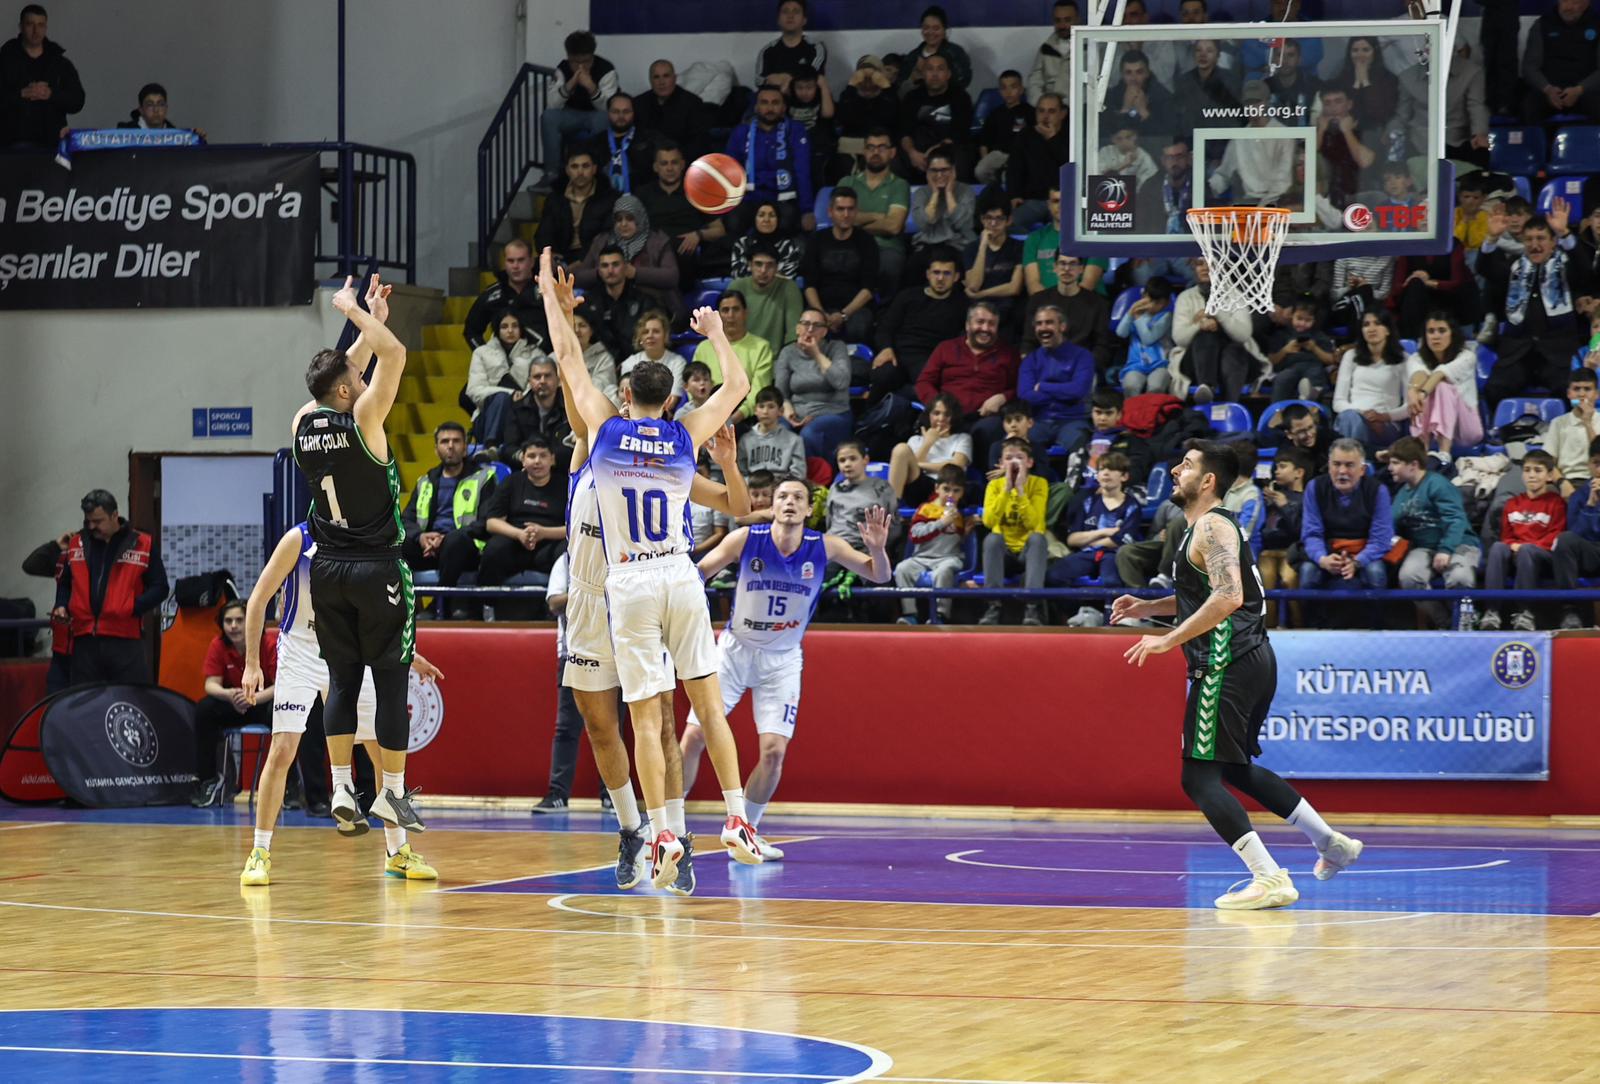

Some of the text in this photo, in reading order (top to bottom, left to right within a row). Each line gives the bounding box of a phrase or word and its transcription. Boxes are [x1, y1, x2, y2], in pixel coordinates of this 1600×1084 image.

[1202, 104, 1307, 119] www.tbf.org.tr
[16, 187, 172, 231] Belediye
[1090, 212, 1133, 222] ALTYAPI
[1374, 205, 1426, 229] TBF
[114, 243, 200, 279] Diler
[321, 432, 350, 454] ÇOLAK
[750, 444, 783, 467] ADIDAS
[320, 475, 348, 529] 1
[621, 487, 668, 543] 10
[768, 595, 787, 617] 15
[1296, 665, 1431, 695] KÜTAHYA
[274, 701, 306, 712] sidera
[782, 703, 798, 725] 15
[1416, 713, 1534, 742] KULÜBÜ
